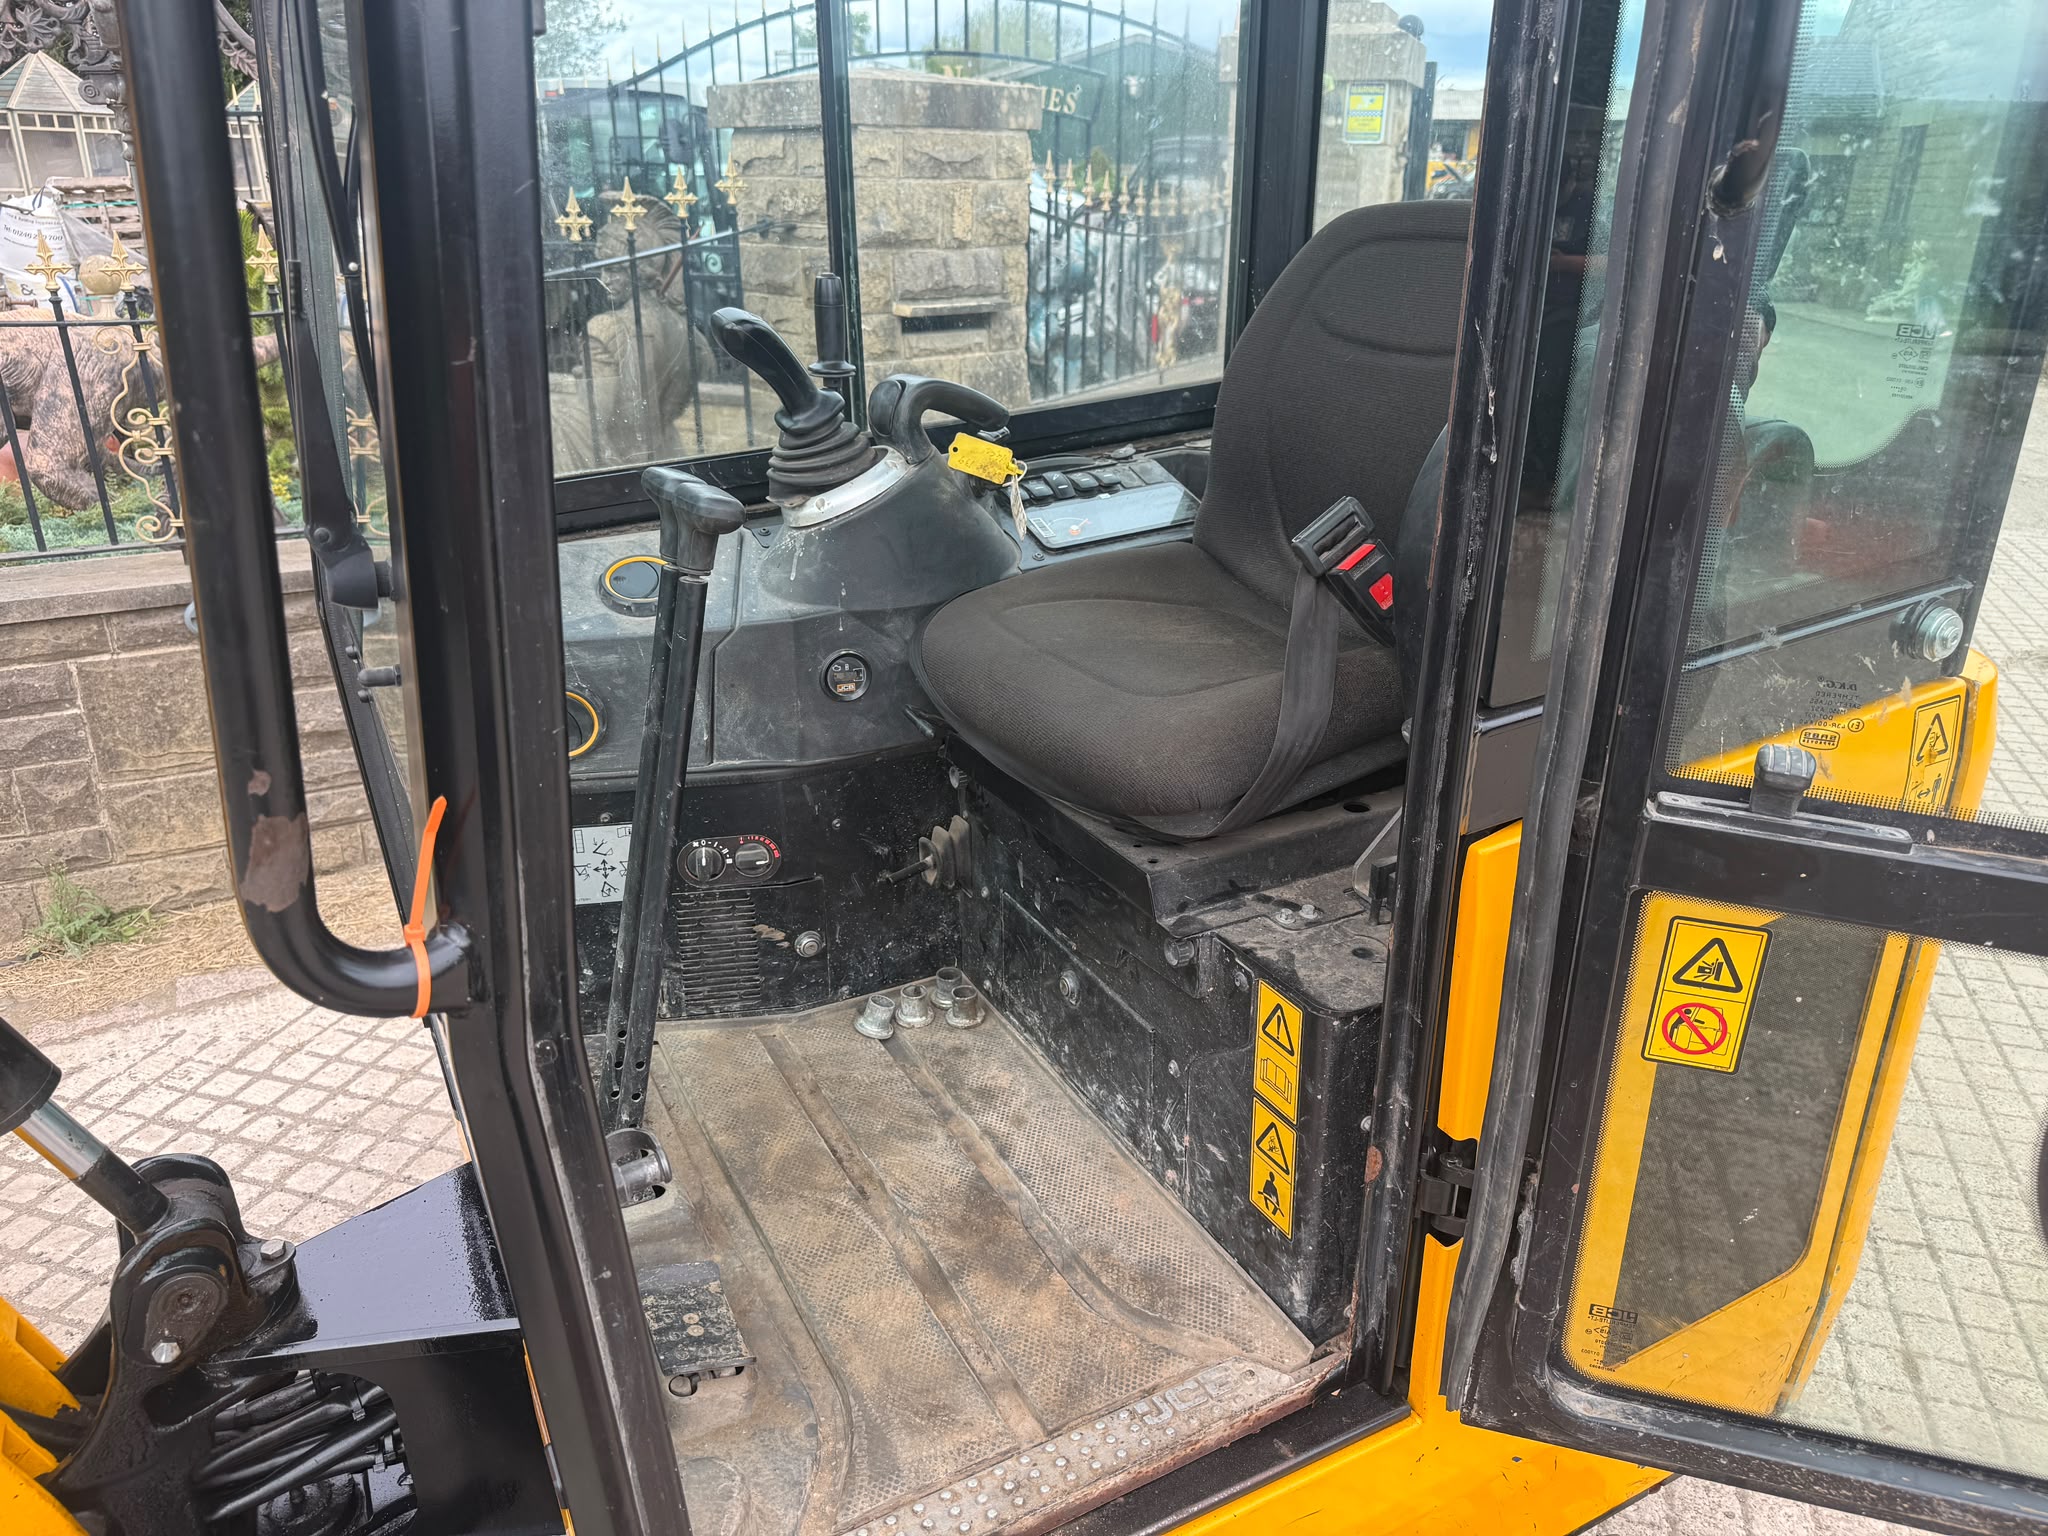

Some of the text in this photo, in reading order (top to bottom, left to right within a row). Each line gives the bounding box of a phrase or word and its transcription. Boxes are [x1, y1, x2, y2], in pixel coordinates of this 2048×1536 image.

[12, 228, 32, 240] 01246
[20, 283, 36, 296] &
[837, 684, 855, 692] JCB
[1133, 1365, 1242, 1425] JCB
